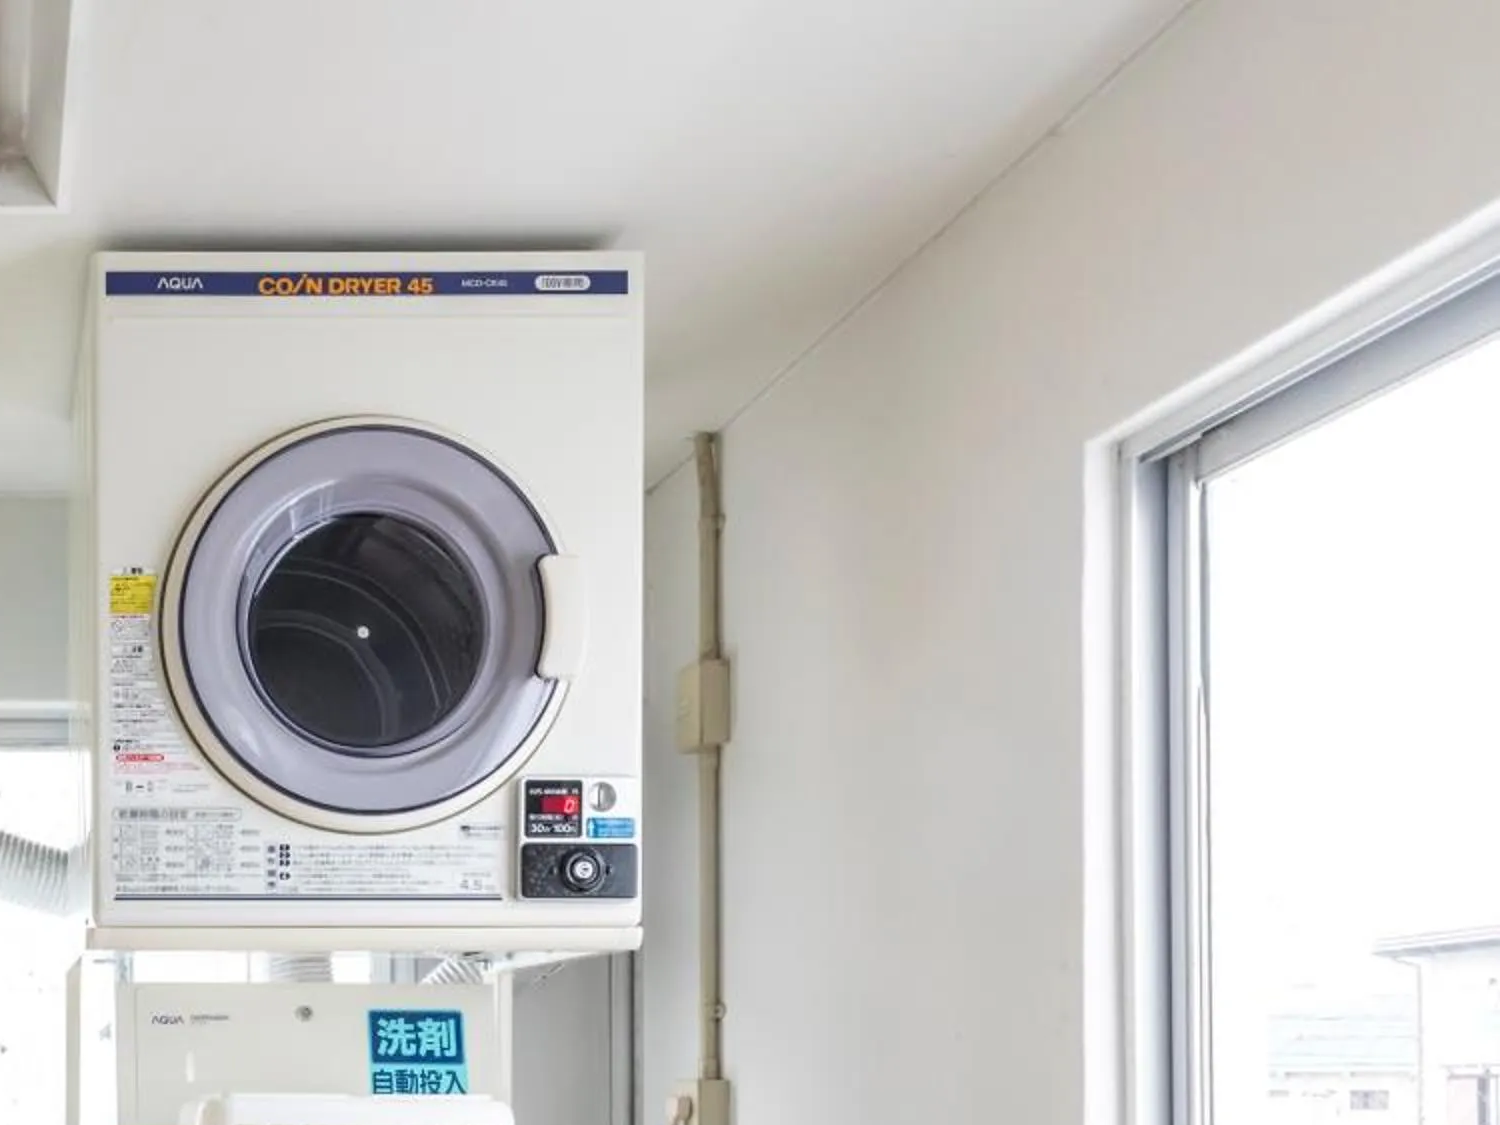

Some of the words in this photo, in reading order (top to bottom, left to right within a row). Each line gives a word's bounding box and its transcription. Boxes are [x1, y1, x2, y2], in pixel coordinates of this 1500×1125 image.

[157, 277, 203, 290] AQUA
[329, 278, 401, 294] DRYER
[407, 278, 433, 294] 45
[151, 1015, 184, 1025] AQUA
[377, 1018, 457, 1057] 洗剤
[373, 1069, 467, 1094] 自動投入
